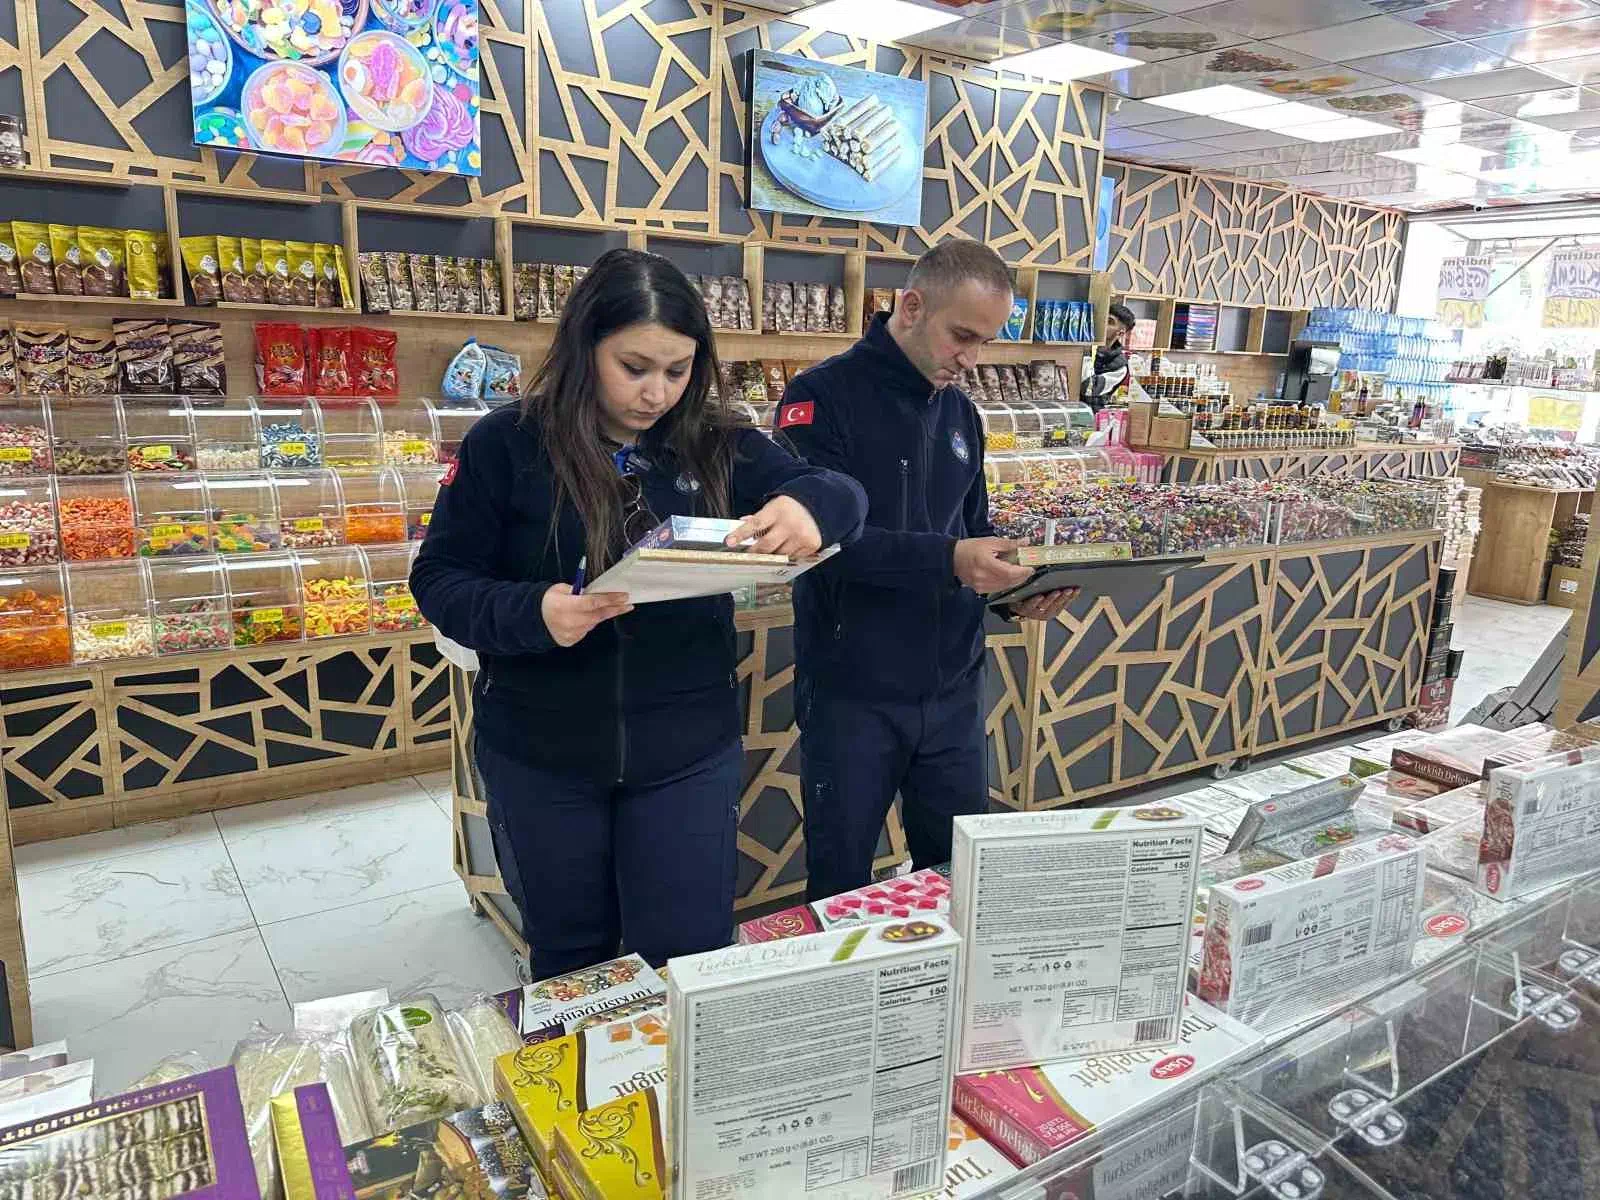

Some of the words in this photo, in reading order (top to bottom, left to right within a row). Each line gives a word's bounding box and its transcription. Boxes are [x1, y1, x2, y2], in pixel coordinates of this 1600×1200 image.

[1133, 838, 1168, 848] Nutrition
[1170, 836, 1193, 846] Facts
[1173, 861, 1189, 870] 150
[879, 964, 921, 979] Nutrition
[924, 958, 949, 970] Facts
[879, 995, 912, 1008] Calories
[929, 985, 947, 997] 150
[955, 1083, 997, 1130] Turkish
[1, 1108, 100, 1143] DELIGHT
